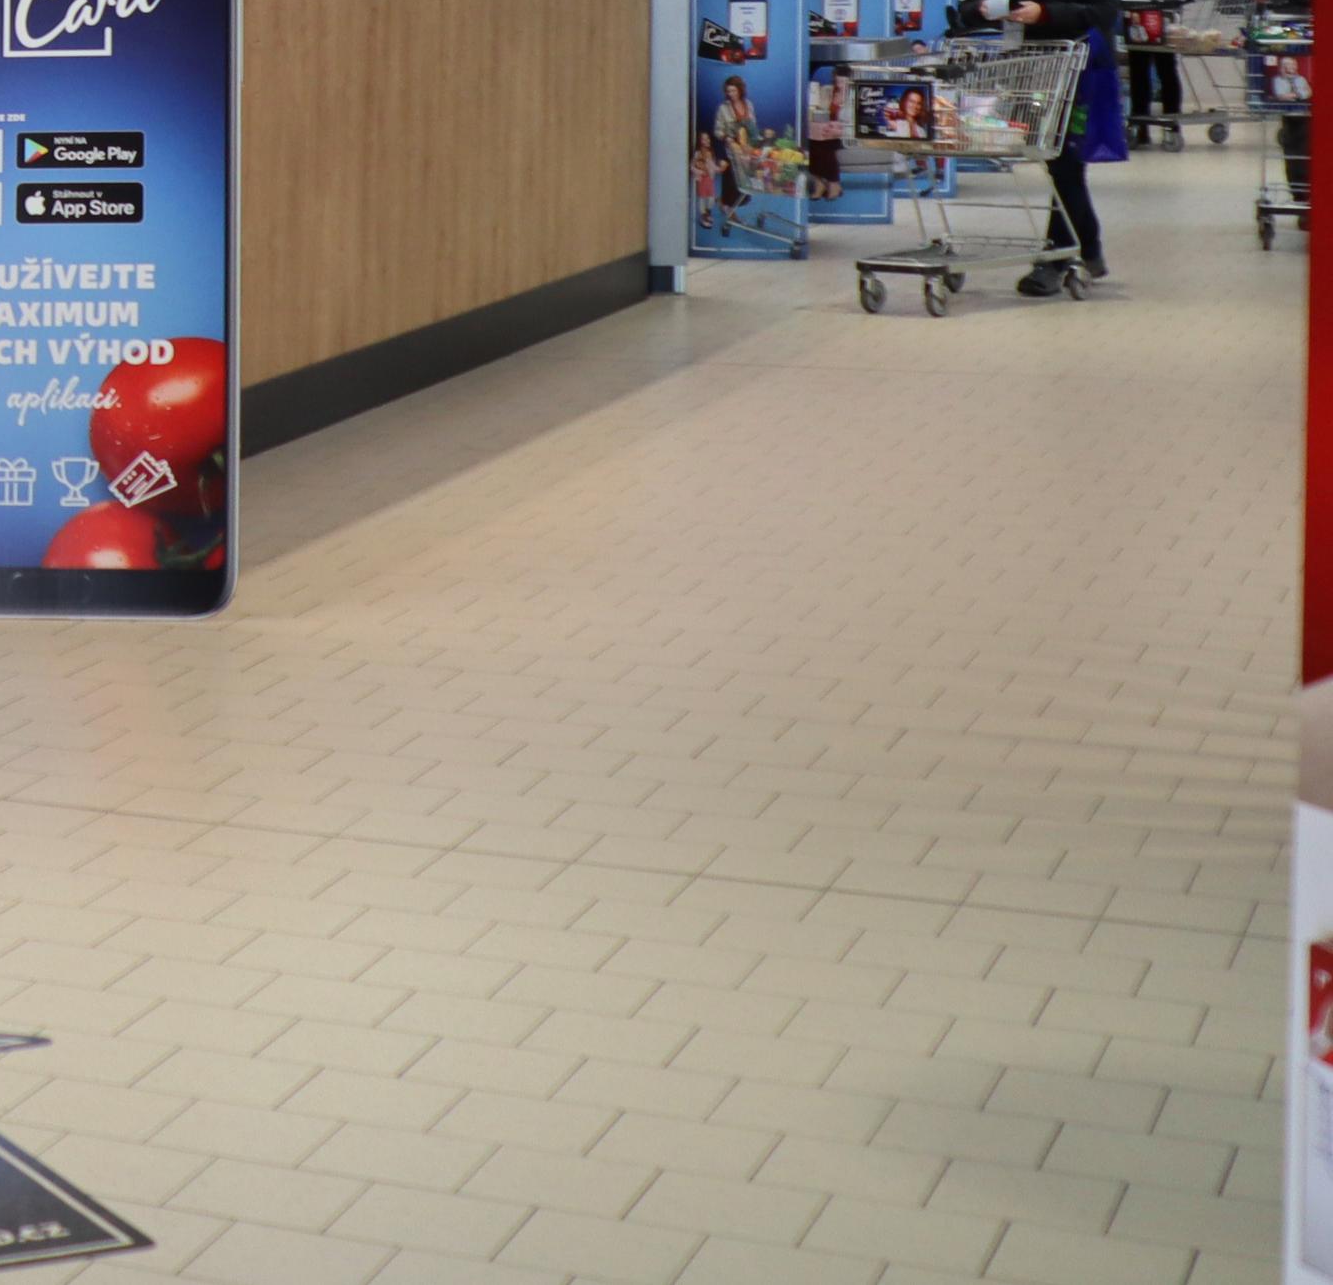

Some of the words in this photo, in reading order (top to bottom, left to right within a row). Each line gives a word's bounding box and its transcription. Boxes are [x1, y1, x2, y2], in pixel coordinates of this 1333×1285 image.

[6, 113, 27, 122] ZDE
[74, 136, 88, 145] NA
[53, 145, 106, 164] Google
[106, 145, 137, 164] Play
[52, 189, 95, 200] Stáhnout
[95, 190, 103, 199] v
[51, 200, 87, 218] App
[89, 200, 136, 217] Store
[47, 332, 175, 366] VÝHOD
[6, 375, 123, 427] aplikaci.
